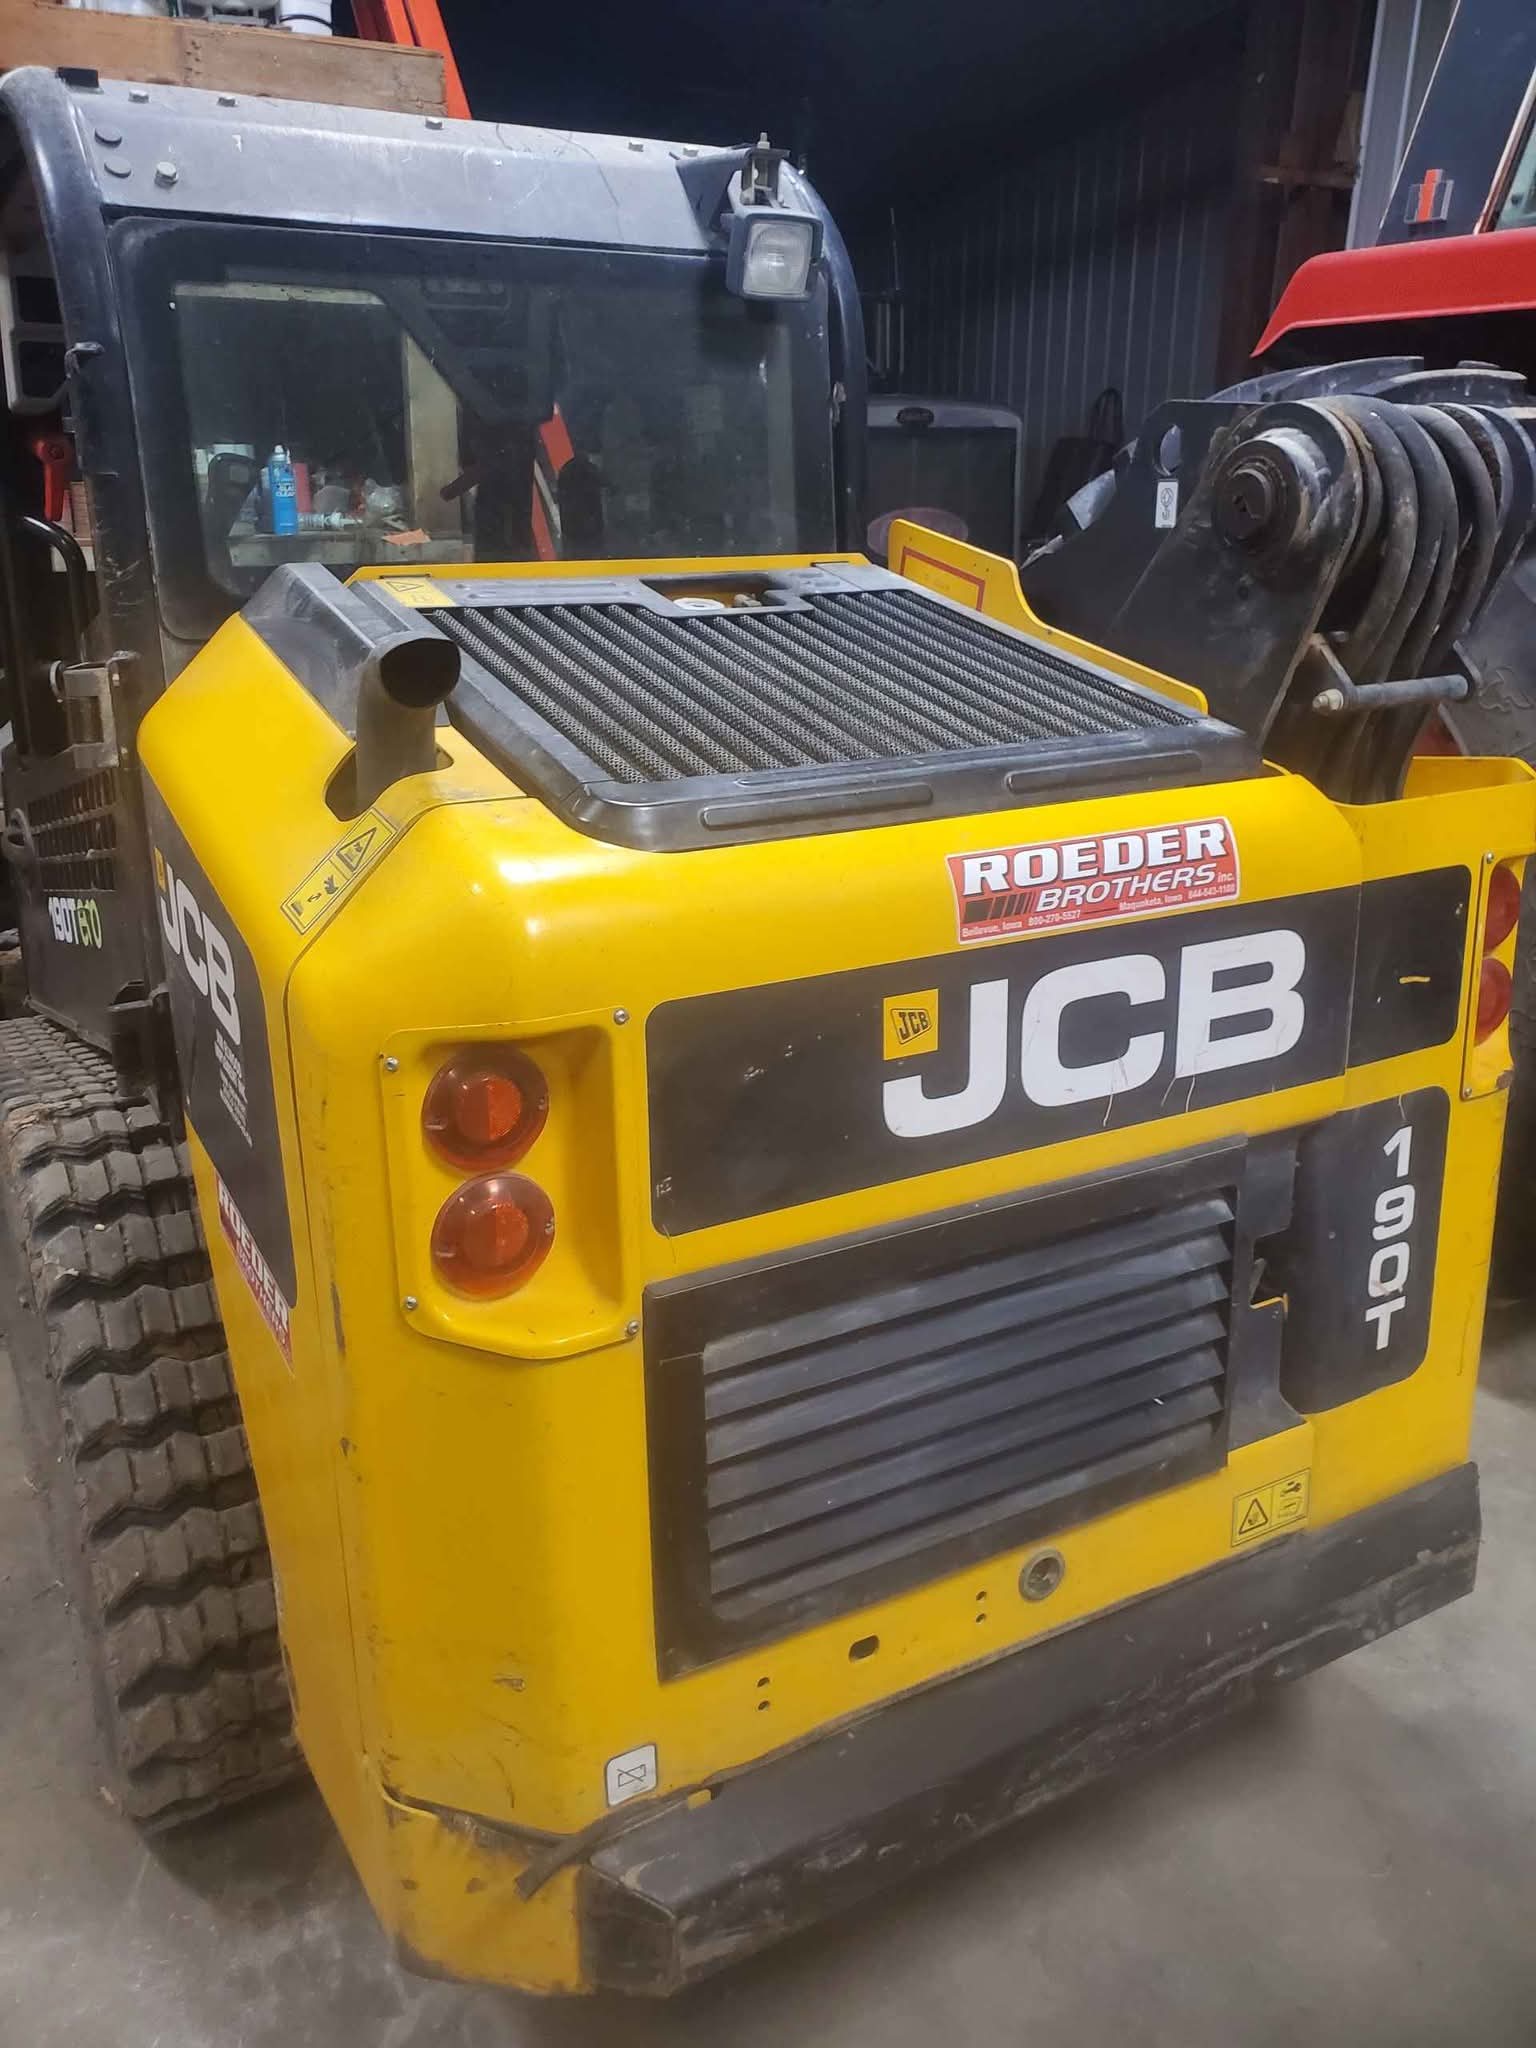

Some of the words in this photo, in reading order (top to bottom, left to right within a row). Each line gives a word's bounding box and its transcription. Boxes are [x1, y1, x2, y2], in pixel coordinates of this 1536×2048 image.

[962, 822, 1228, 896] ROEDER
[1035, 862, 1218, 913] BROTHERS
[160, 862, 241, 1046] JCB
[883, 929, 1306, 1139] JCB
[897, 1009, 930, 1041] JCB
[218, 1179, 289, 1332] ROEDER
